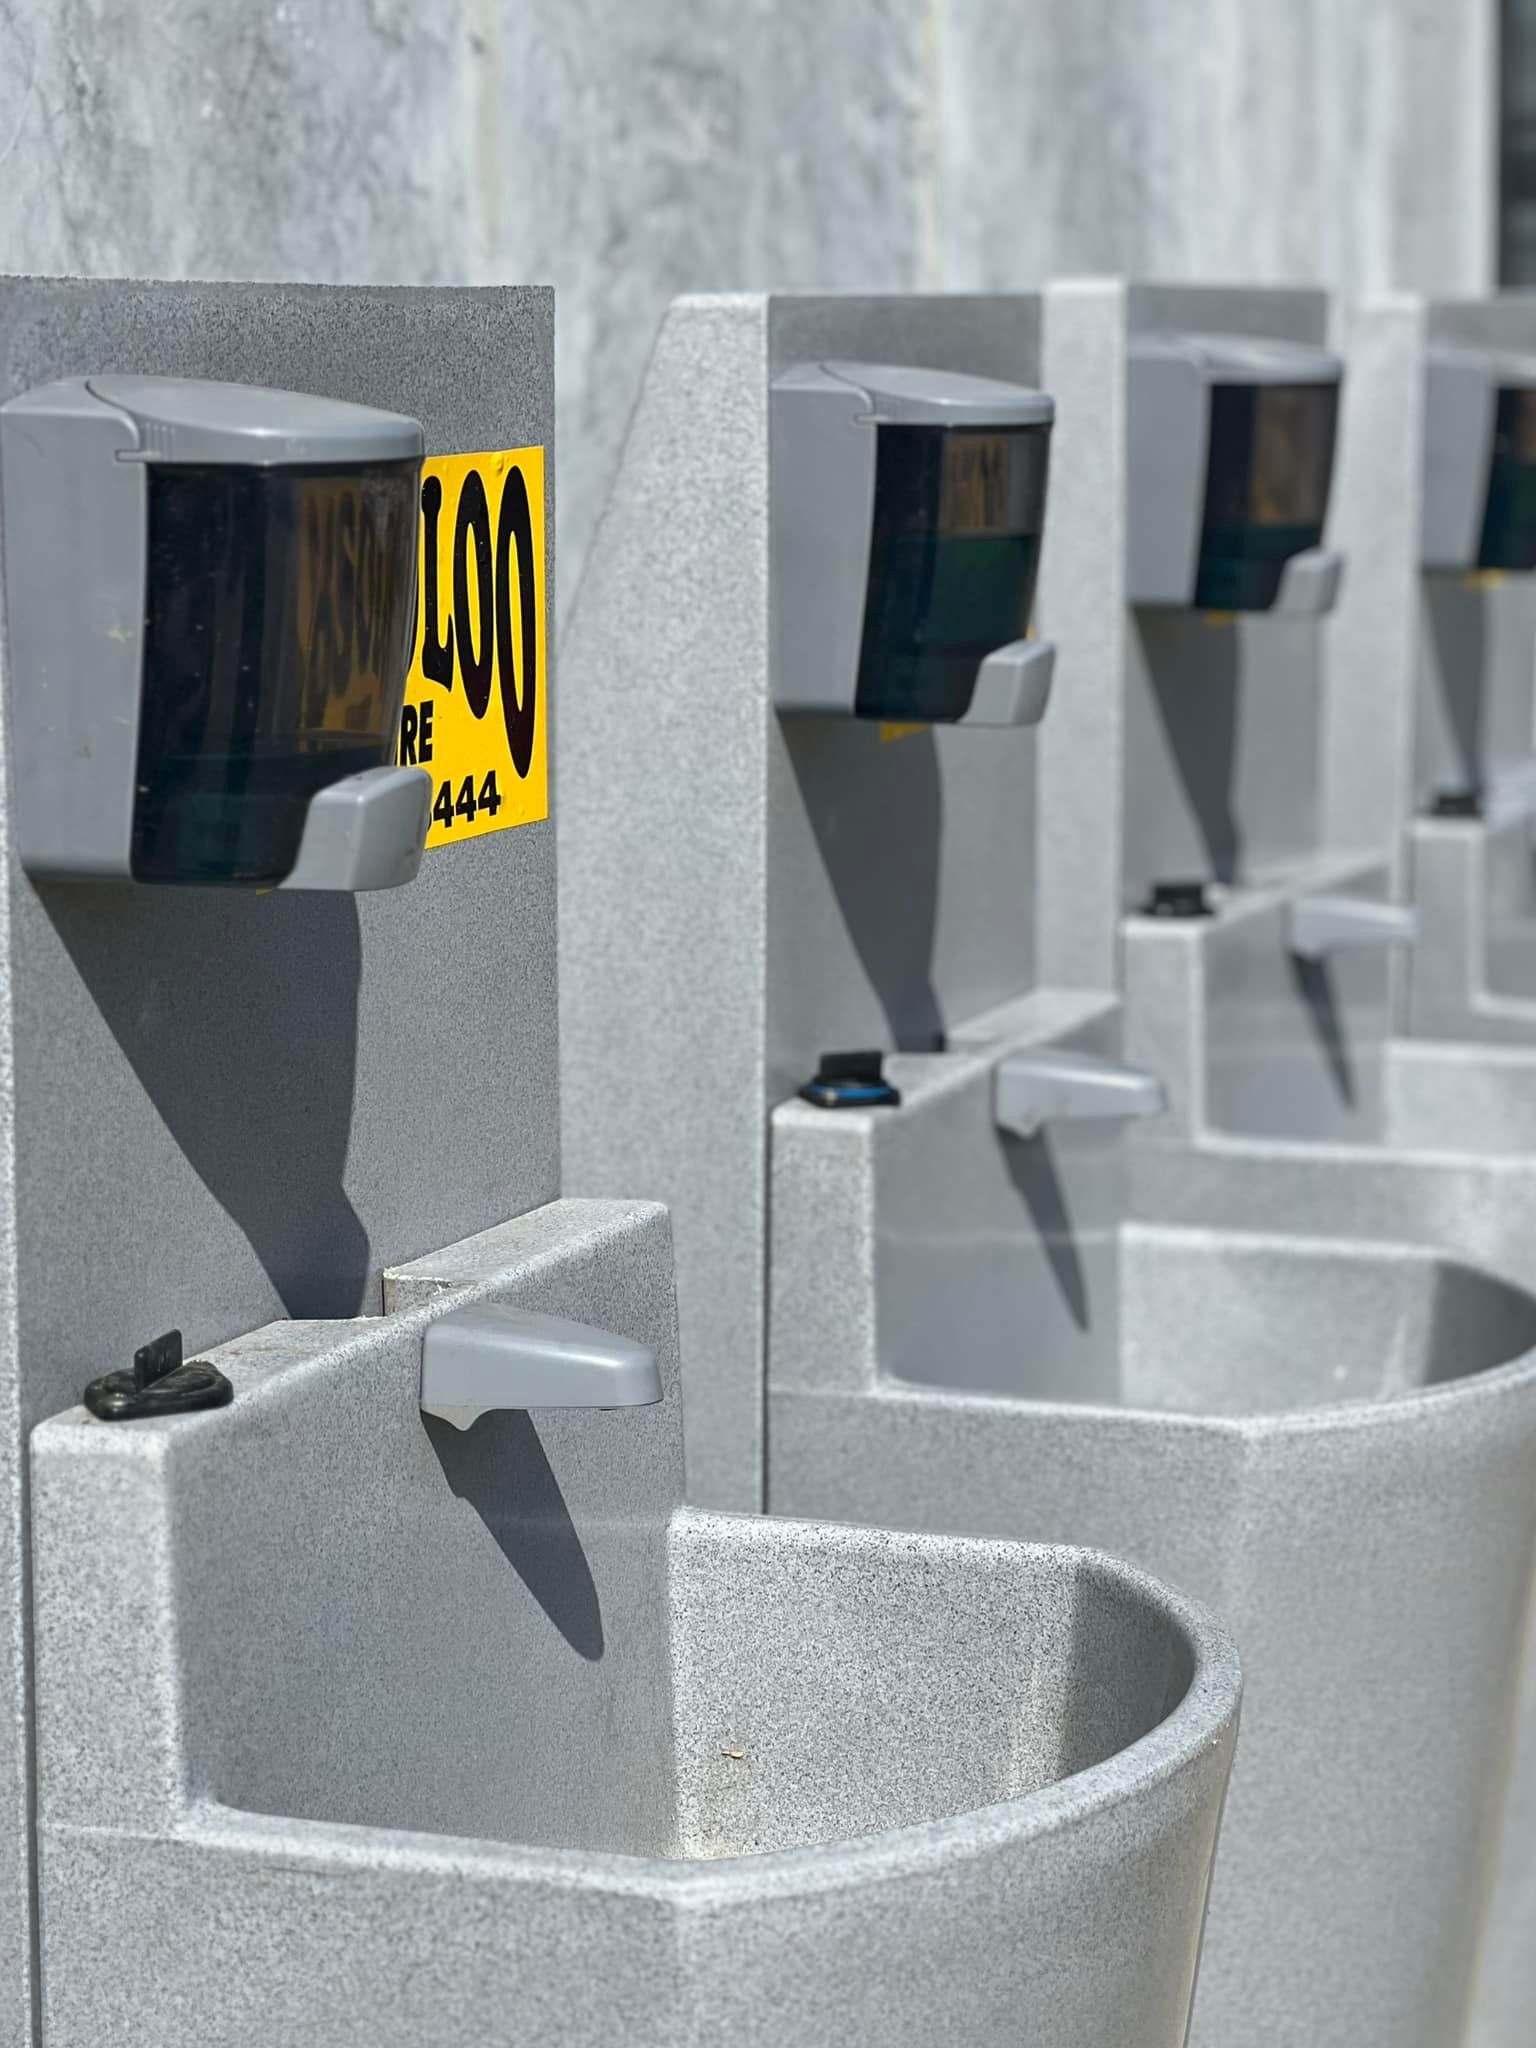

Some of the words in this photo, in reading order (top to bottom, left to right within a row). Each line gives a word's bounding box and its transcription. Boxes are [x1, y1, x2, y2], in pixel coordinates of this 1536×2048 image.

[409, 465, 536, 779] LOO
[396, 699, 434, 766] RE
[428, 770, 502, 832] 444
